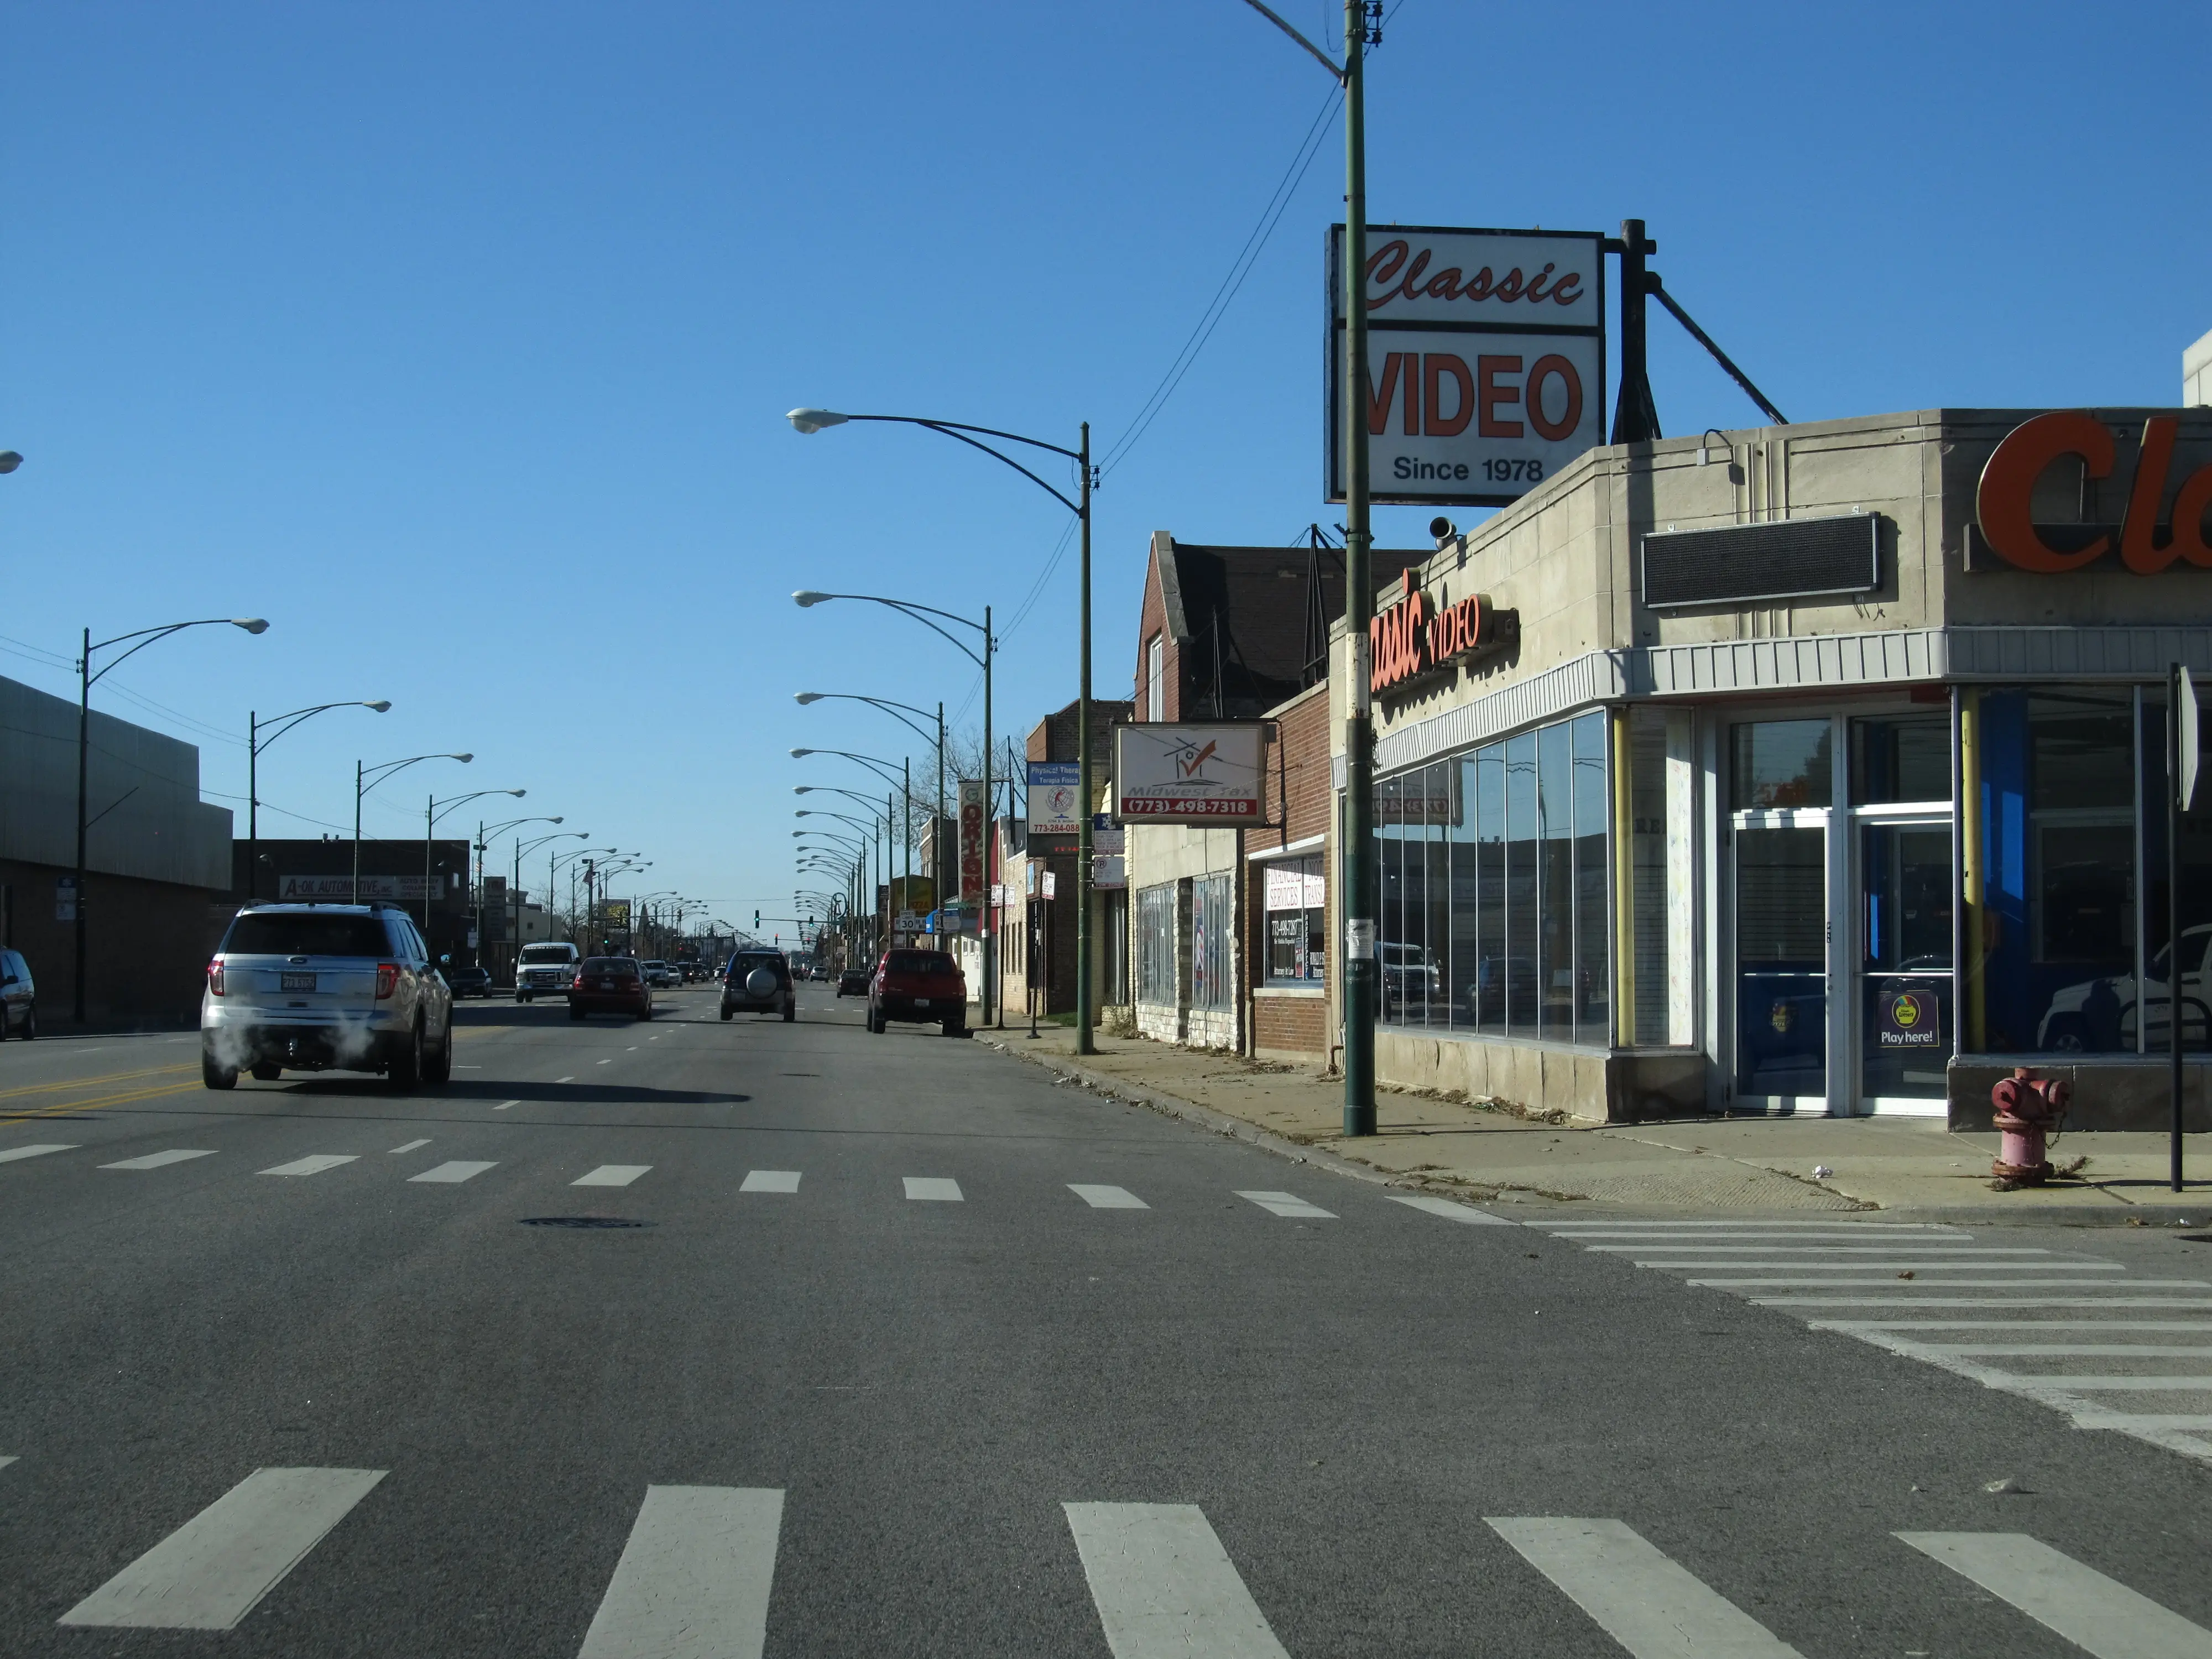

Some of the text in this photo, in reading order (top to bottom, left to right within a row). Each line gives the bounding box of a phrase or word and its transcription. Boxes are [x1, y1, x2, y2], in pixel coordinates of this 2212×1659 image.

[1366, 239, 1584, 311] Classic
[1367, 352, 1583, 441] VIDEO
[1393, 456, 1543, 482] Since 1978
[1428, 593, 1481, 665] VIDEO
[1031, 766, 1058, 775] Physical
[1128, 786, 1252, 797] Midwest Tax
[1128, 800, 1248, 813] (773) 498-7318
[1034, 823, 1080, 832] 773-284-088
[1267, 862, 1302, 885] FINANCIAL
[285, 878, 314, 896] A-OK
[317, 880, 380, 895] AUTOMTIVE,
[1270, 886, 1298, 907] SERVICES
[1881, 1030, 1933, 1045] Play here!
